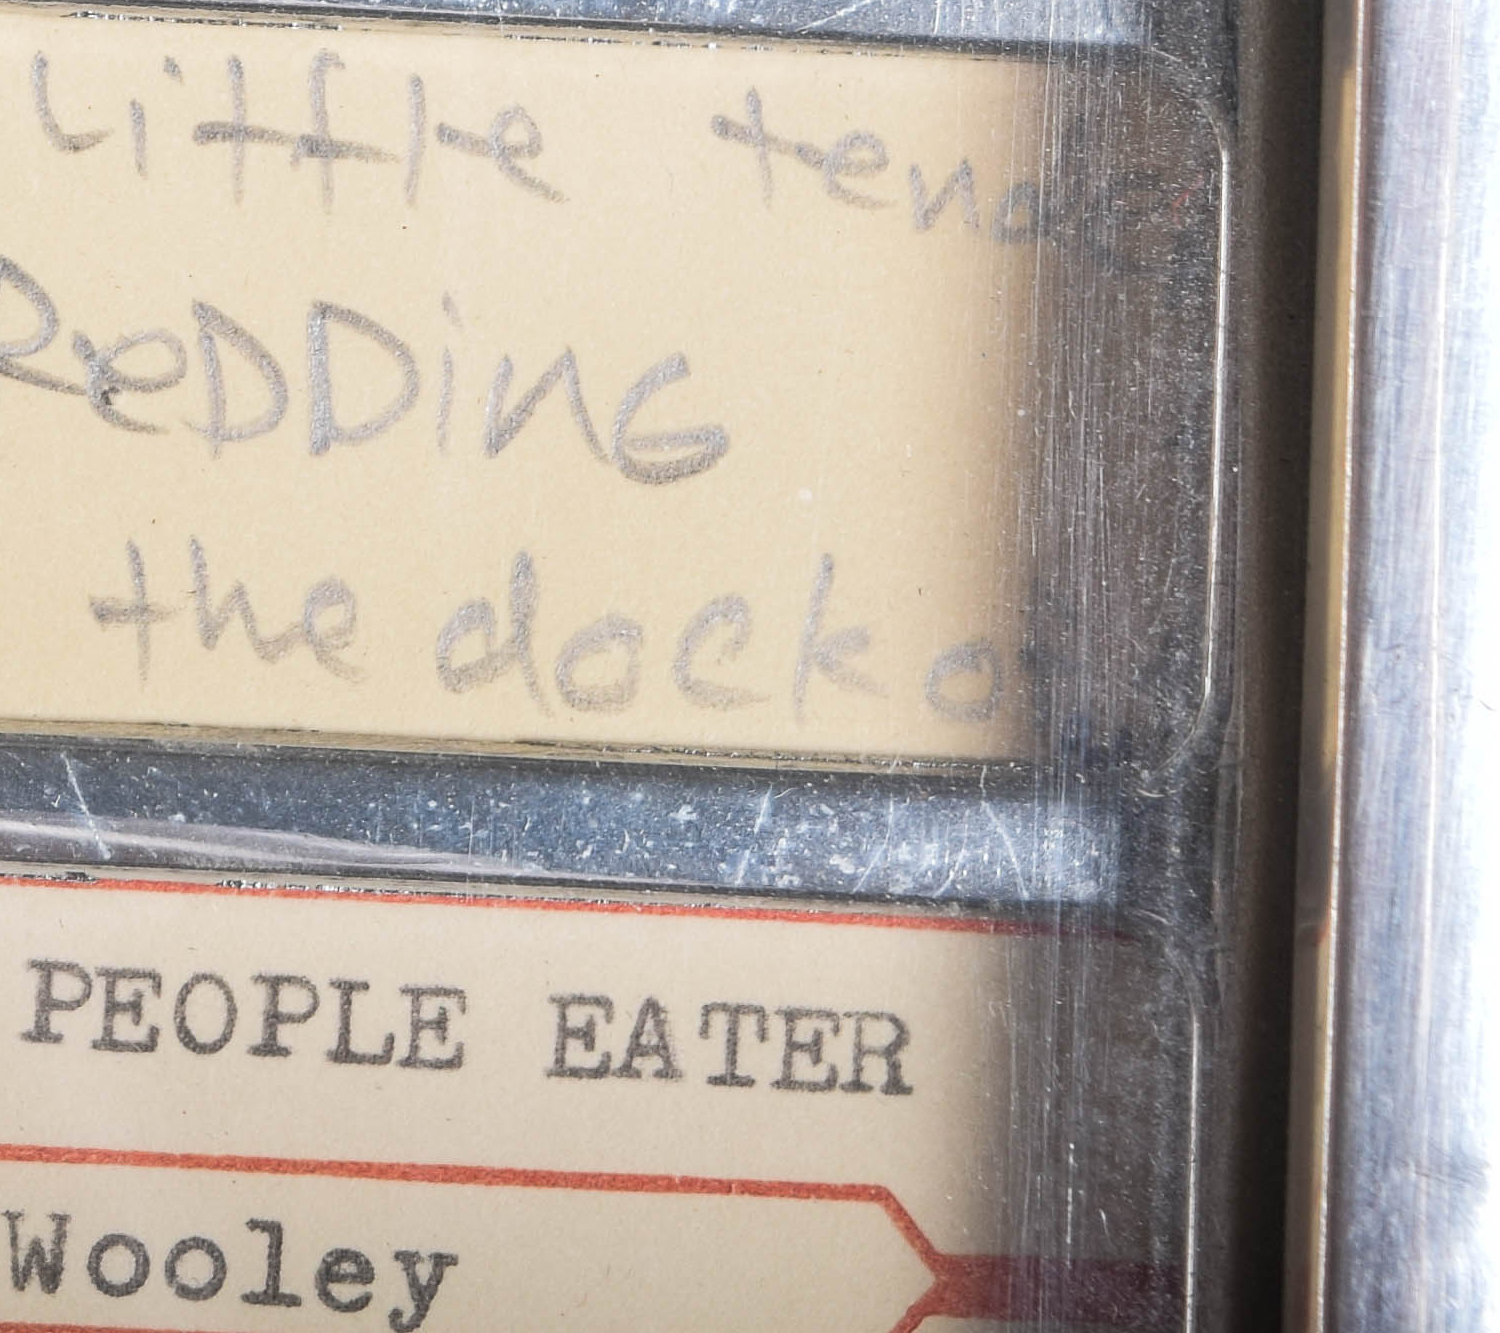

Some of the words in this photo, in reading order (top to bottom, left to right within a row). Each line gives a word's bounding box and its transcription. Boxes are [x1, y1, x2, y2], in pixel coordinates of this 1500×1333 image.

[85, 533, 371, 685] the
[19, 958, 468, 1072] PEOPLE
[545, 992, 916, 1098] EATER
[1, 1208, 460, 1333] Wooley
